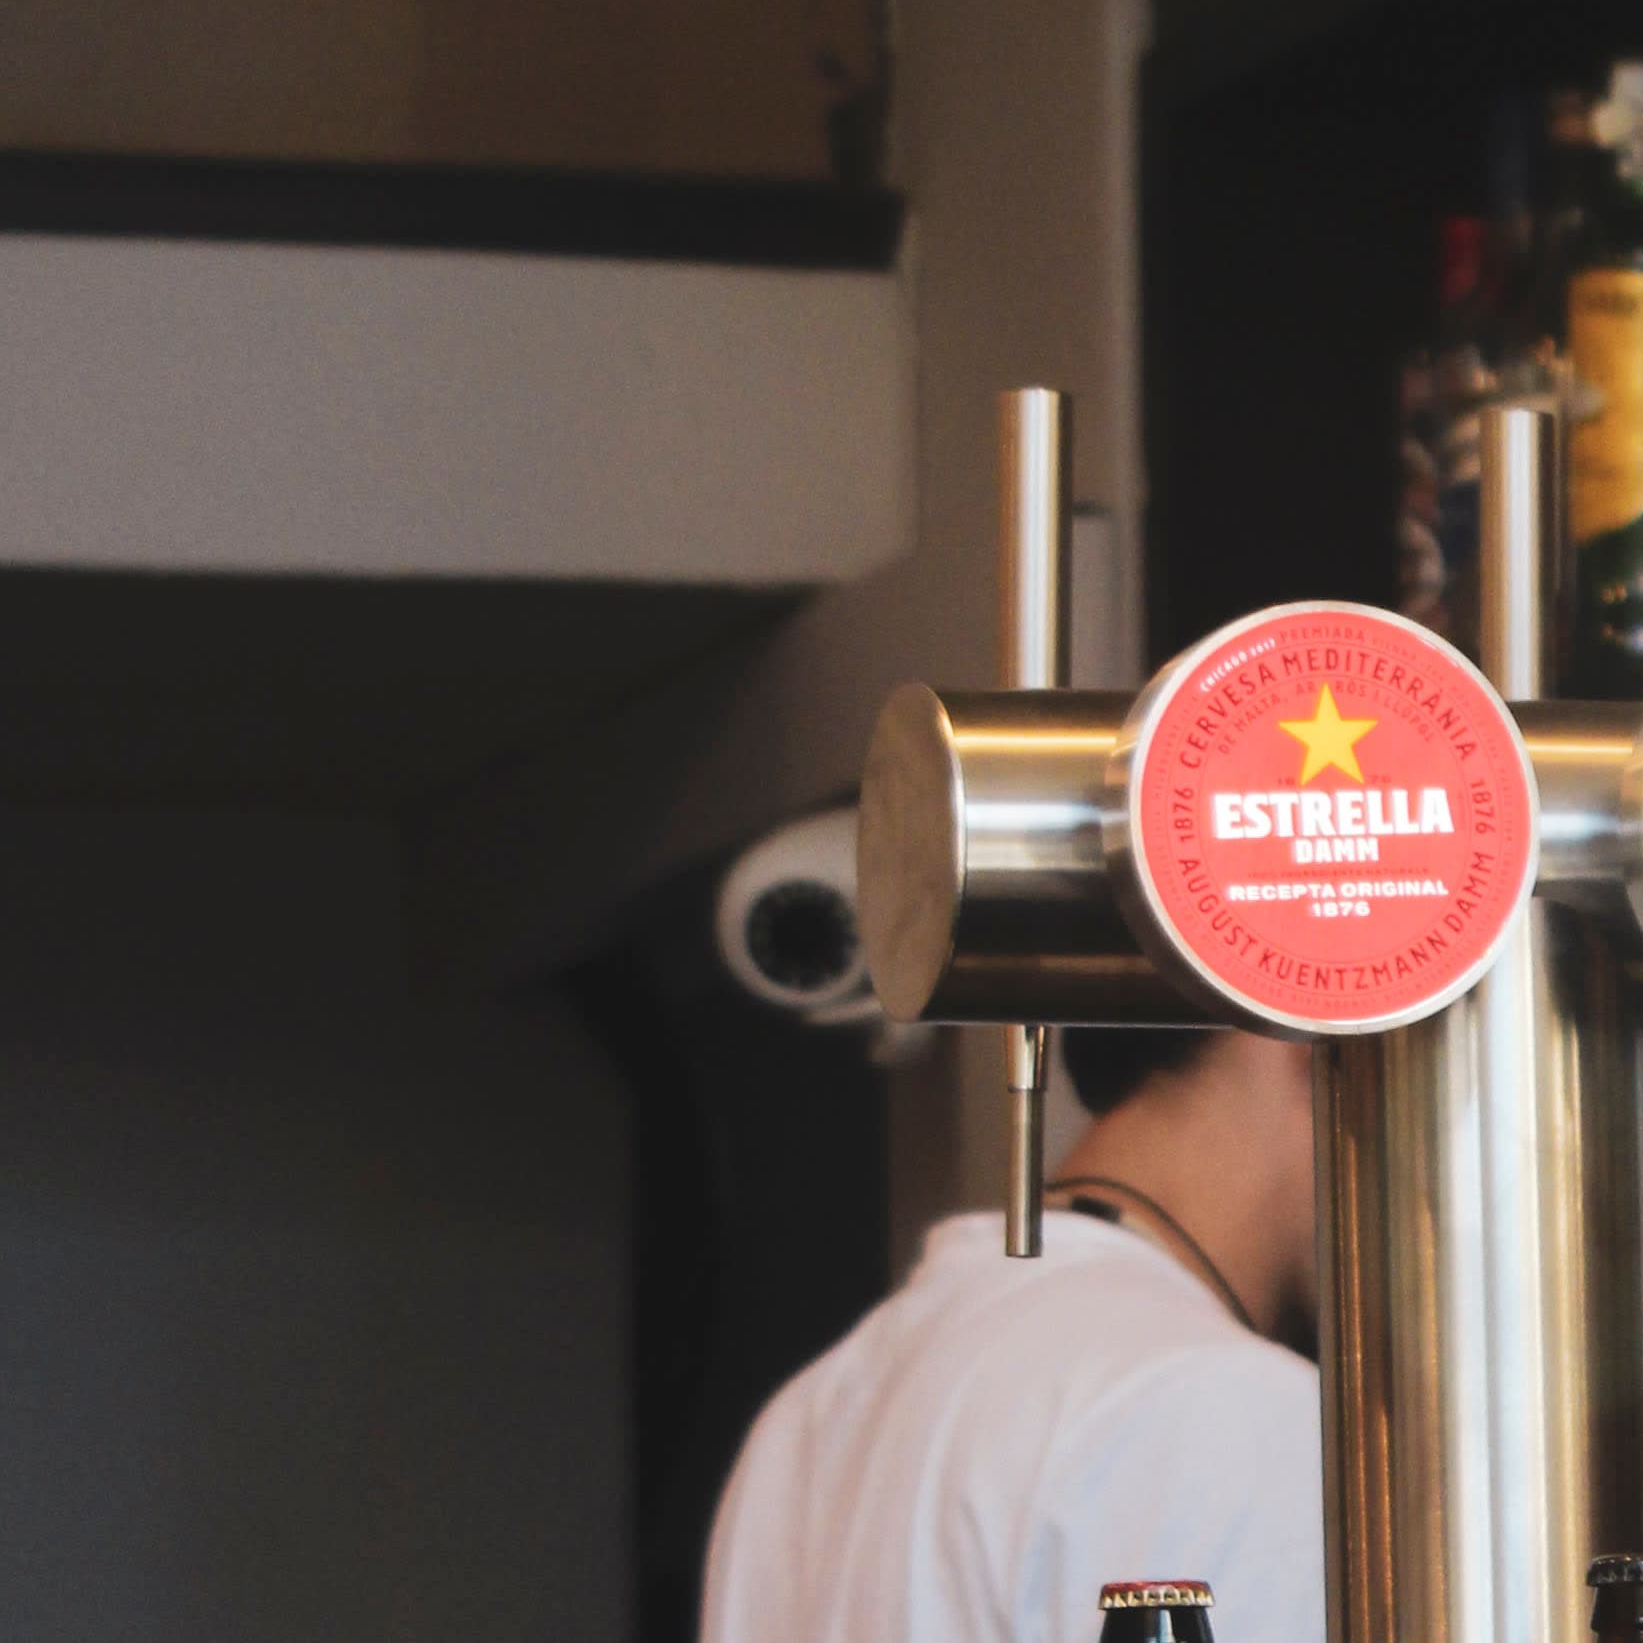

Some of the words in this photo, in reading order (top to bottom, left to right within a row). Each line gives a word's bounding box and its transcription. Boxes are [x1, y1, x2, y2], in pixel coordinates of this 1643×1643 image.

[1180, 661, 1277, 770] CERVESA
[1174, 787, 1196, 844] 1876
[1212, 787, 1455, 841] ESTRELLA
[1470, 779, 1496, 834] 1876
[1294, 837, 1380, 865] DAMM
[1227, 883, 1337, 902] RECEPTA
[1339, 879, 1449, 898] ORIGINAL
[1311, 900, 1371, 918] 1876
[1178, 857, 1258, 957] AUGUST
[1257, 931, 1447, 991] KUENTZMANN
[1444, 851, 1495, 934] DAMM
